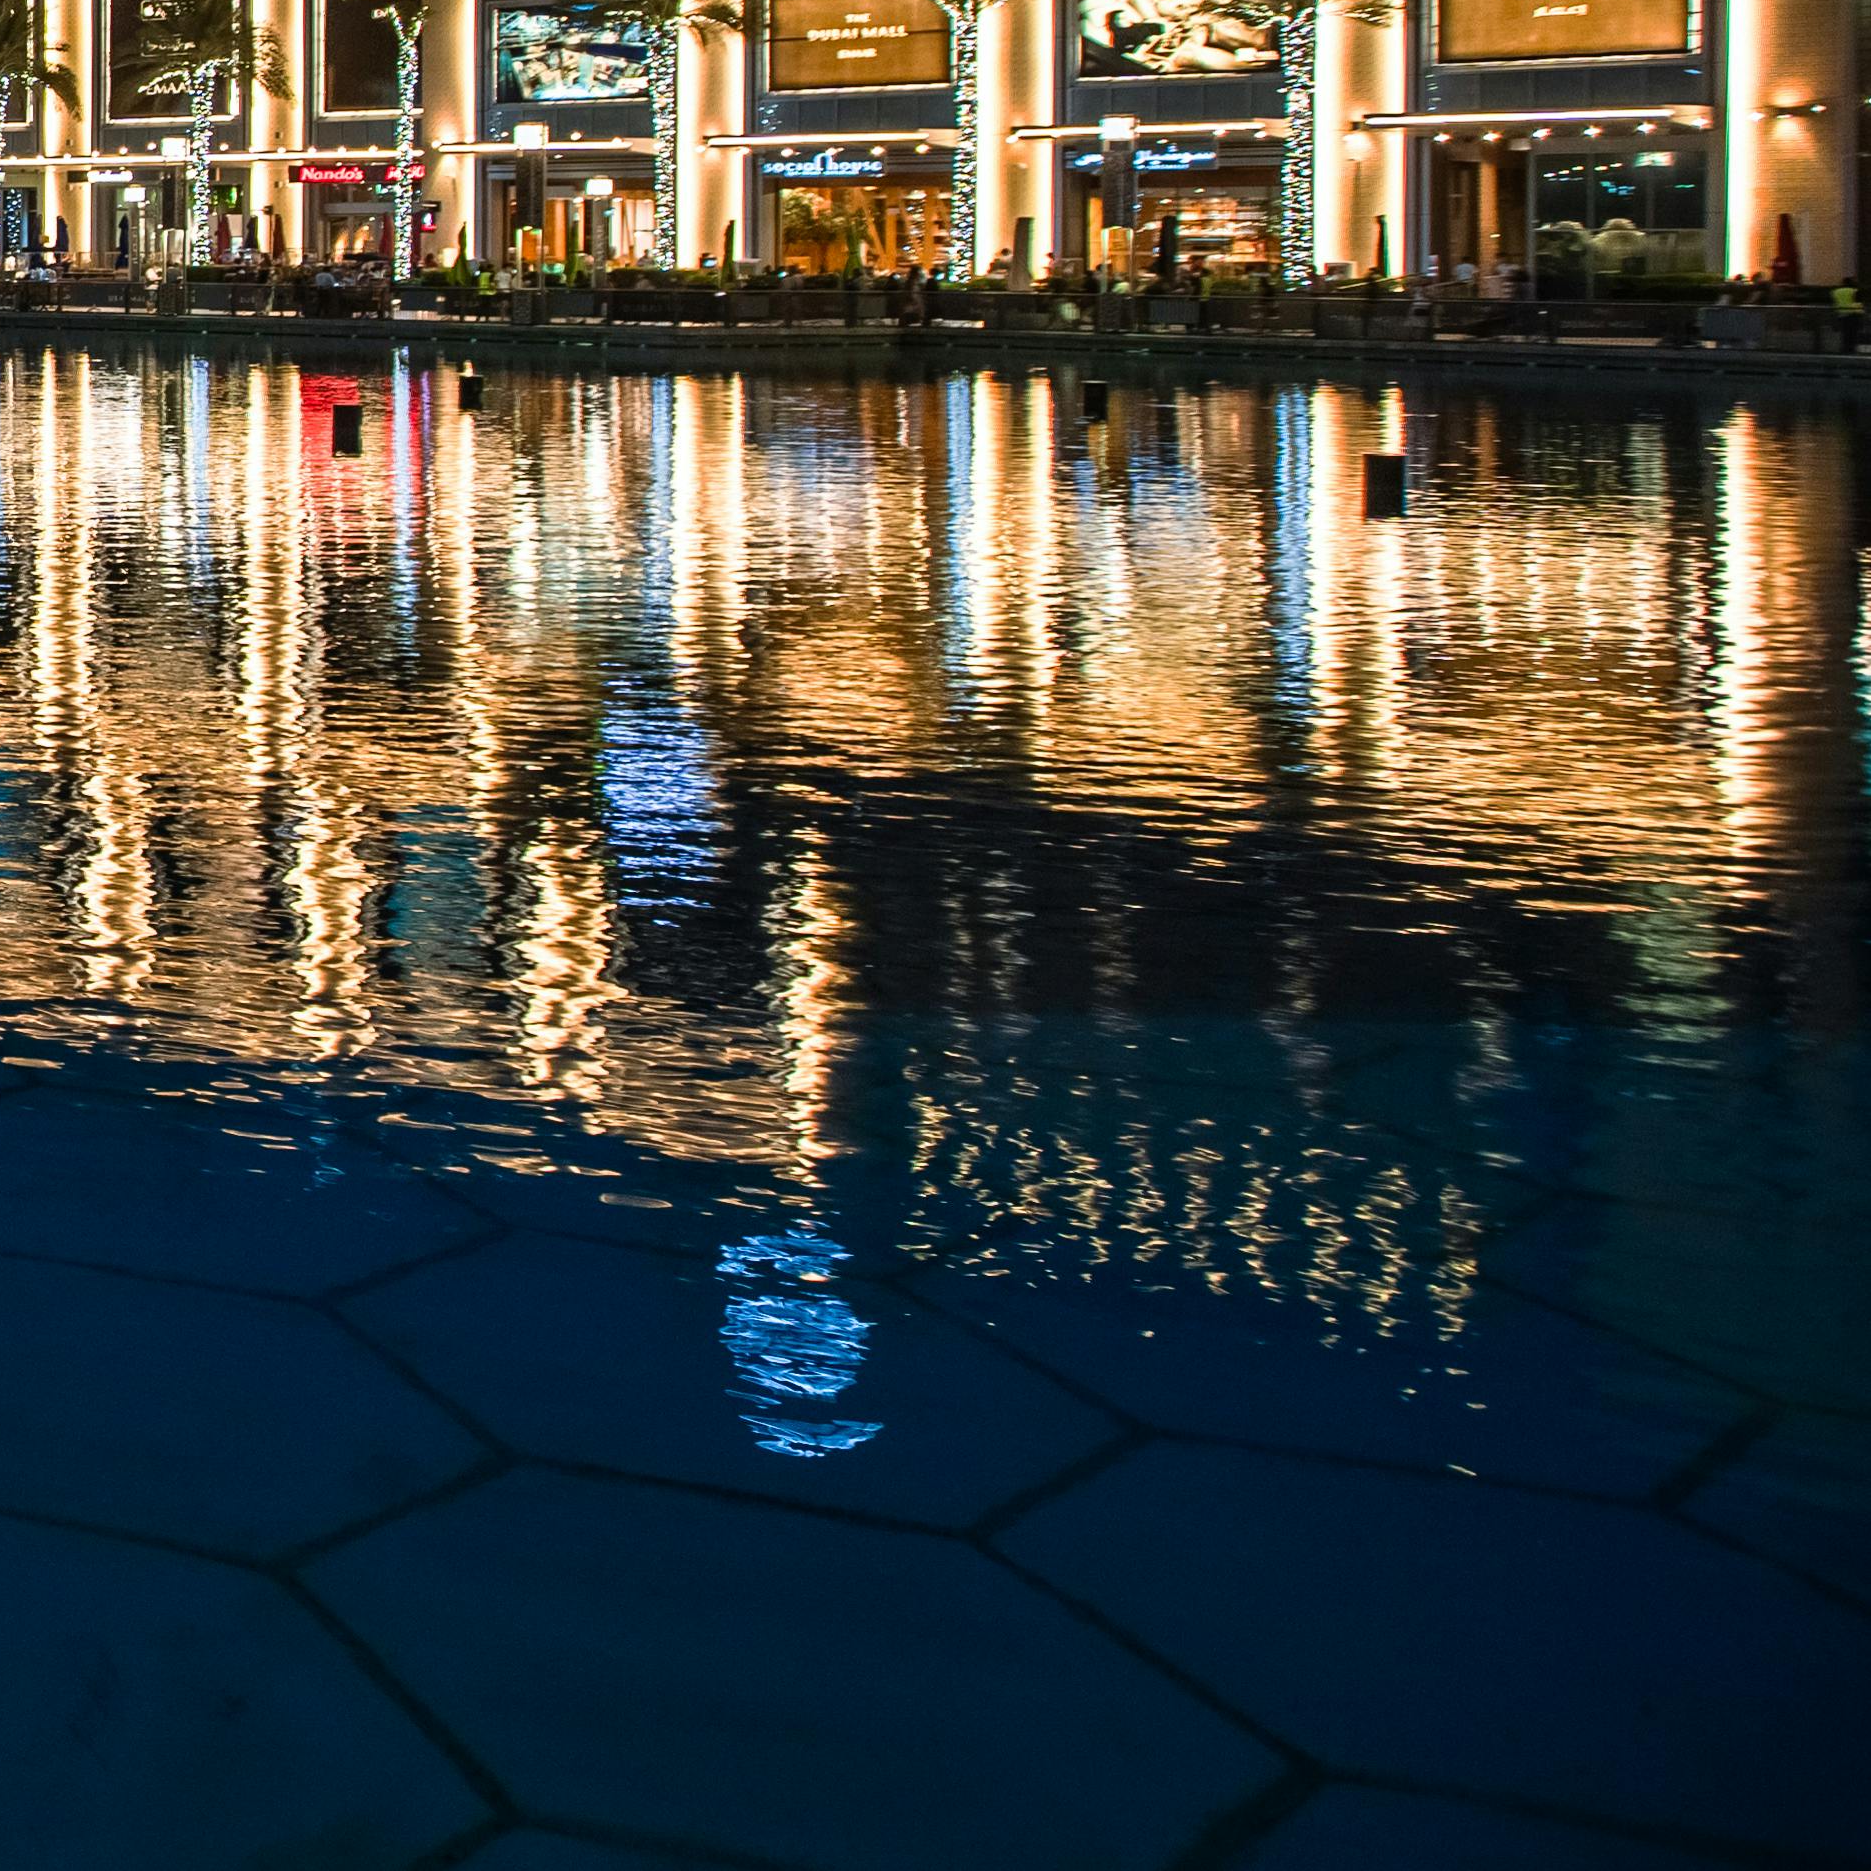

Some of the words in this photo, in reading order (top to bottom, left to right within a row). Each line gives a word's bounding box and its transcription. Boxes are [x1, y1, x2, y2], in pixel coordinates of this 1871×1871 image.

[844, 12, 872, 24] THE
[806, 27, 859, 42] DUBAI
[860, 25, 909, 39] MALL
[146, 81, 195, 96] EMAA
[300, 166, 365, 182] Nando's
